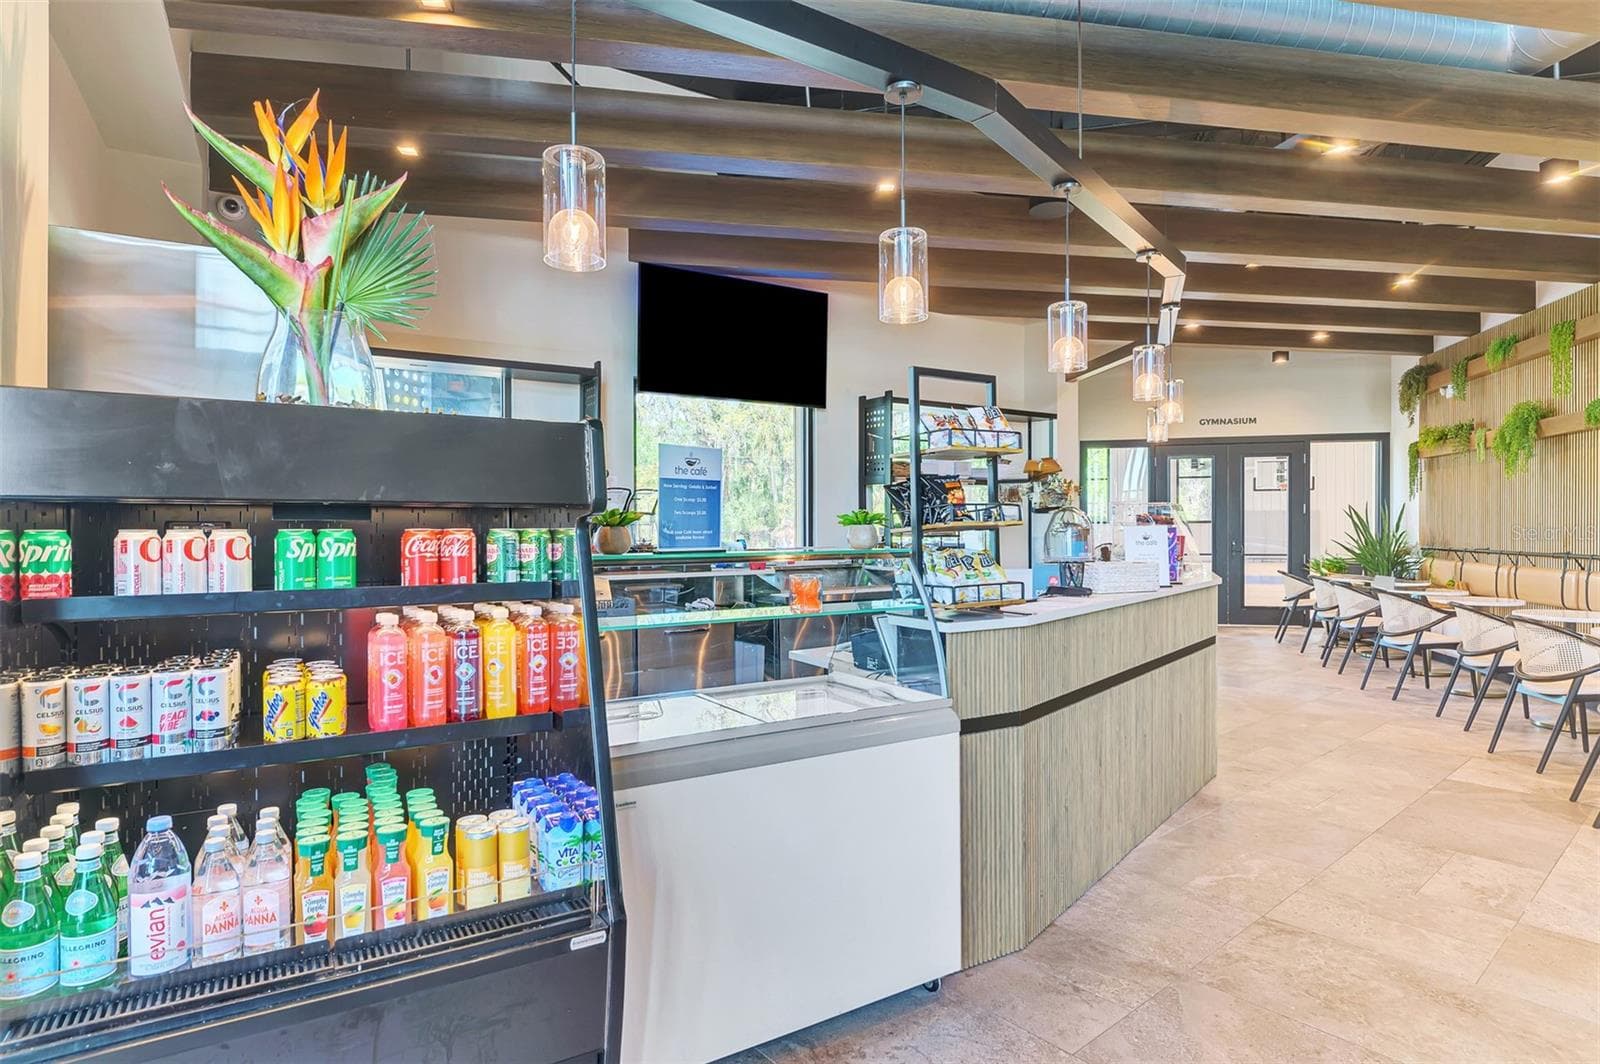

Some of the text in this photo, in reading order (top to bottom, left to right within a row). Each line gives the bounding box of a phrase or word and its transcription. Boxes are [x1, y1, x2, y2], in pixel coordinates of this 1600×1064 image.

[1199, 417, 1257, 426] GYMNASIUM
[674, 465, 708, 476] the café
[527, 639, 548, 652] ICE
[422, 648, 446, 663] ICE
[454, 646, 479, 660] ICE
[380, 652, 405, 667] ICE
[36, 710, 64, 719] CELSIUS
[75, 707, 104, 716] CELSIUS
[116, 705, 143, 713] CELSIUS
[558, 847, 579, 858] VITA
[146, 907, 166, 961] evian
